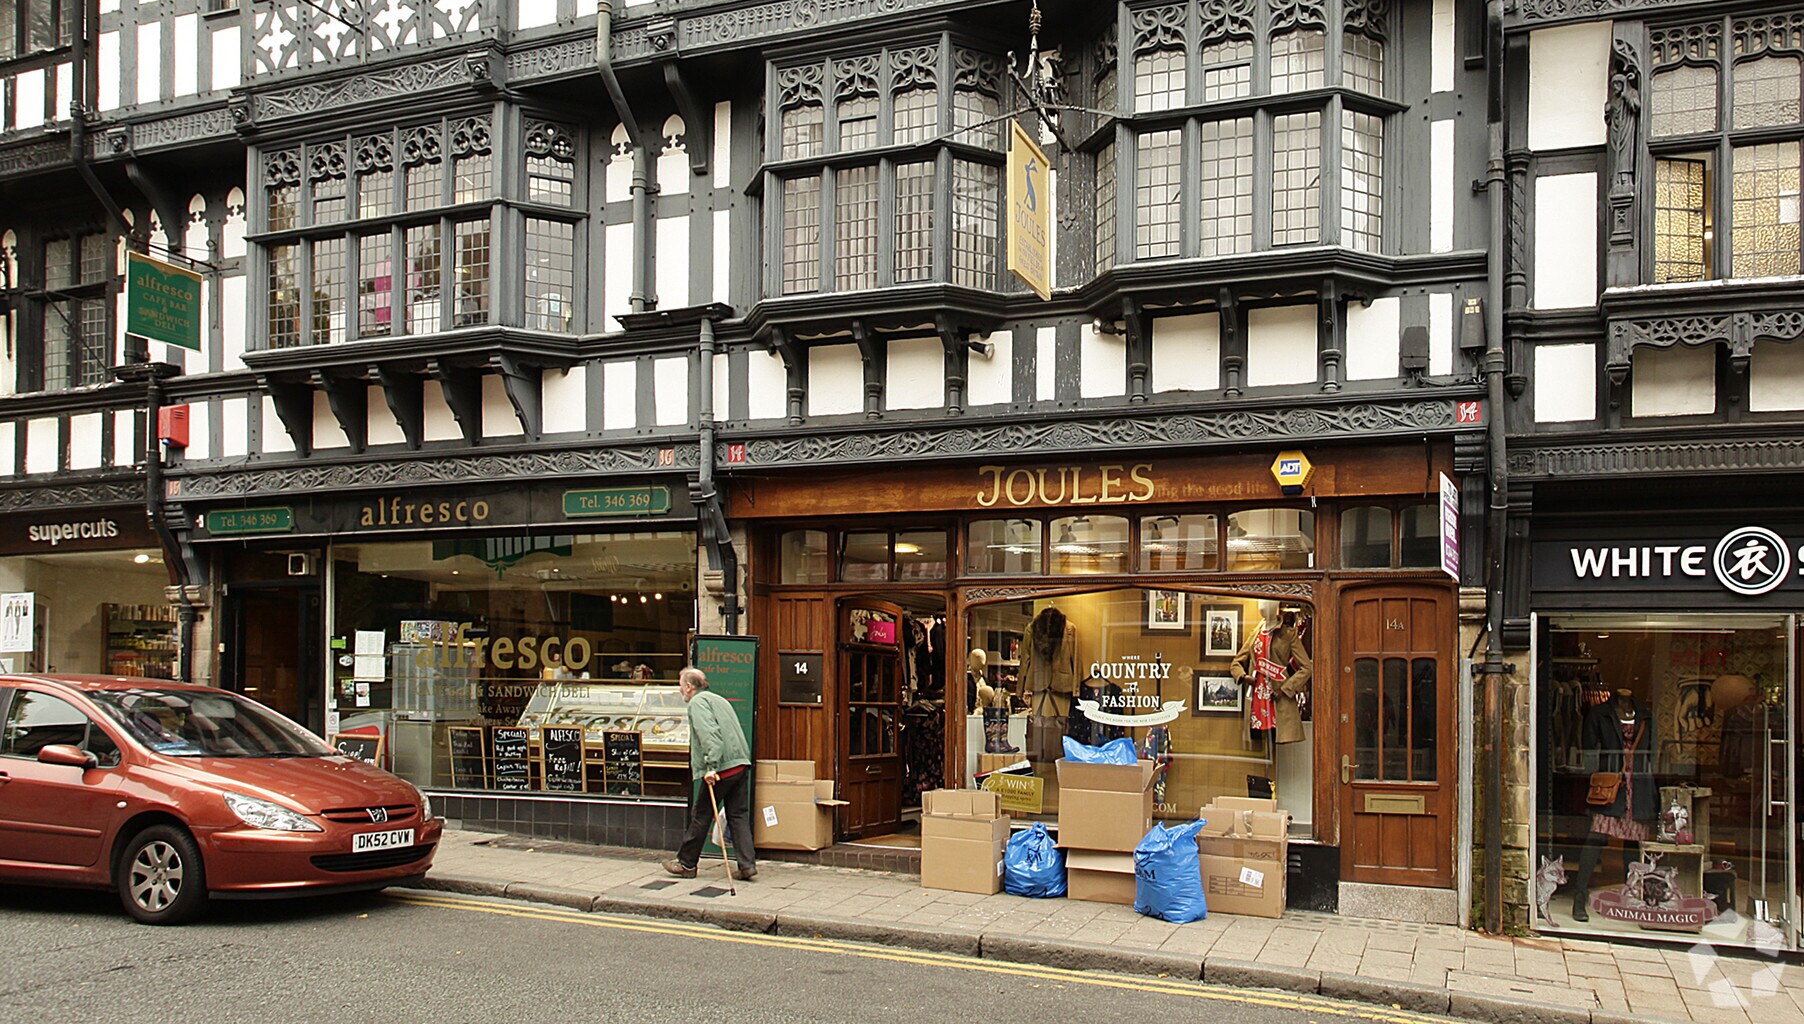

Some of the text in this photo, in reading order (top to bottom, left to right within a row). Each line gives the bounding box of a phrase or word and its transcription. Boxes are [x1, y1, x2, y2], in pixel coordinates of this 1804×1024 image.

[1015, 202, 1046, 248] JOULES
[136, 274, 193, 302] alfresco
[1280, 462, 1301, 474] ADT
[976, 463, 1154, 507] JOULES
[580, 493, 650, 509] Tel. 346 369
[360, 496, 489, 526] alfresco
[221, 516, 238, 527] Tel.
[260, 514, 277, 526] 369
[28, 517, 119, 546] supercuts
[1570, 546, 1707, 578] WHITE
[1386, 618, 1405, 630] 14A
[415, 620, 592, 671] alfresco
[698, 646, 753, 664] alfresco
[794, 662, 808, 675] 14
[1090, 662, 1172, 679] COUNTRY
[488, 685, 560, 699] SANDWICH
[561, 686, 590, 698] DELI
[495, 704, 520, 715] Away
[1101, 695, 1161, 708] FASHION
[1006, 779, 1027, 790] WIN
[358, 832, 388, 848] DK52
[1606, 907, 1698, 923] ANIMAL MAGIC
